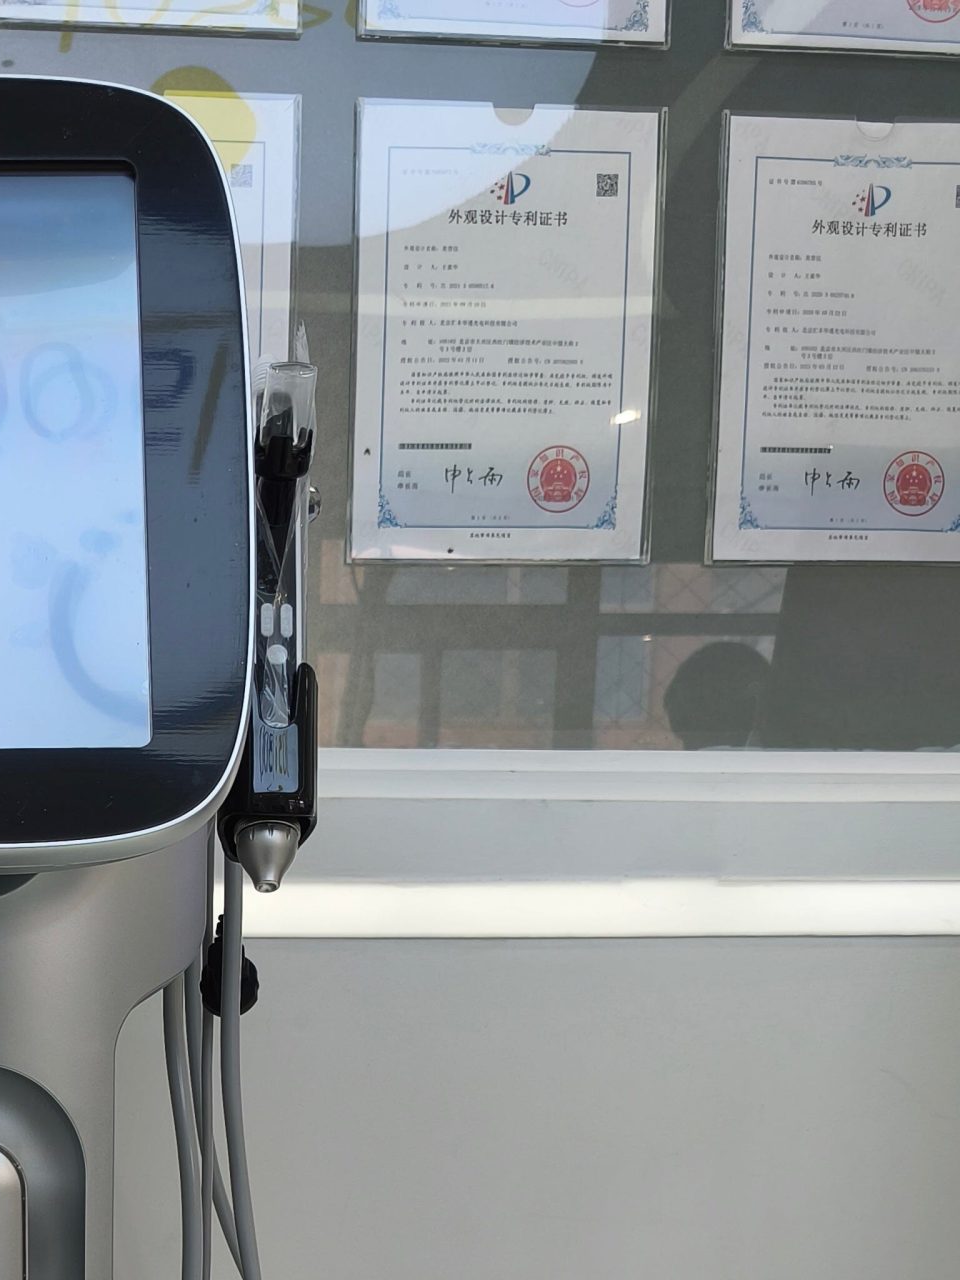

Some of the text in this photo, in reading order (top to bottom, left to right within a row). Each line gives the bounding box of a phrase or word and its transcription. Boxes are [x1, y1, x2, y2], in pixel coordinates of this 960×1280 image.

[448, 208, 568, 227] 外观设计专利证书
[812, 219, 928, 237] 外观设计专利证书
